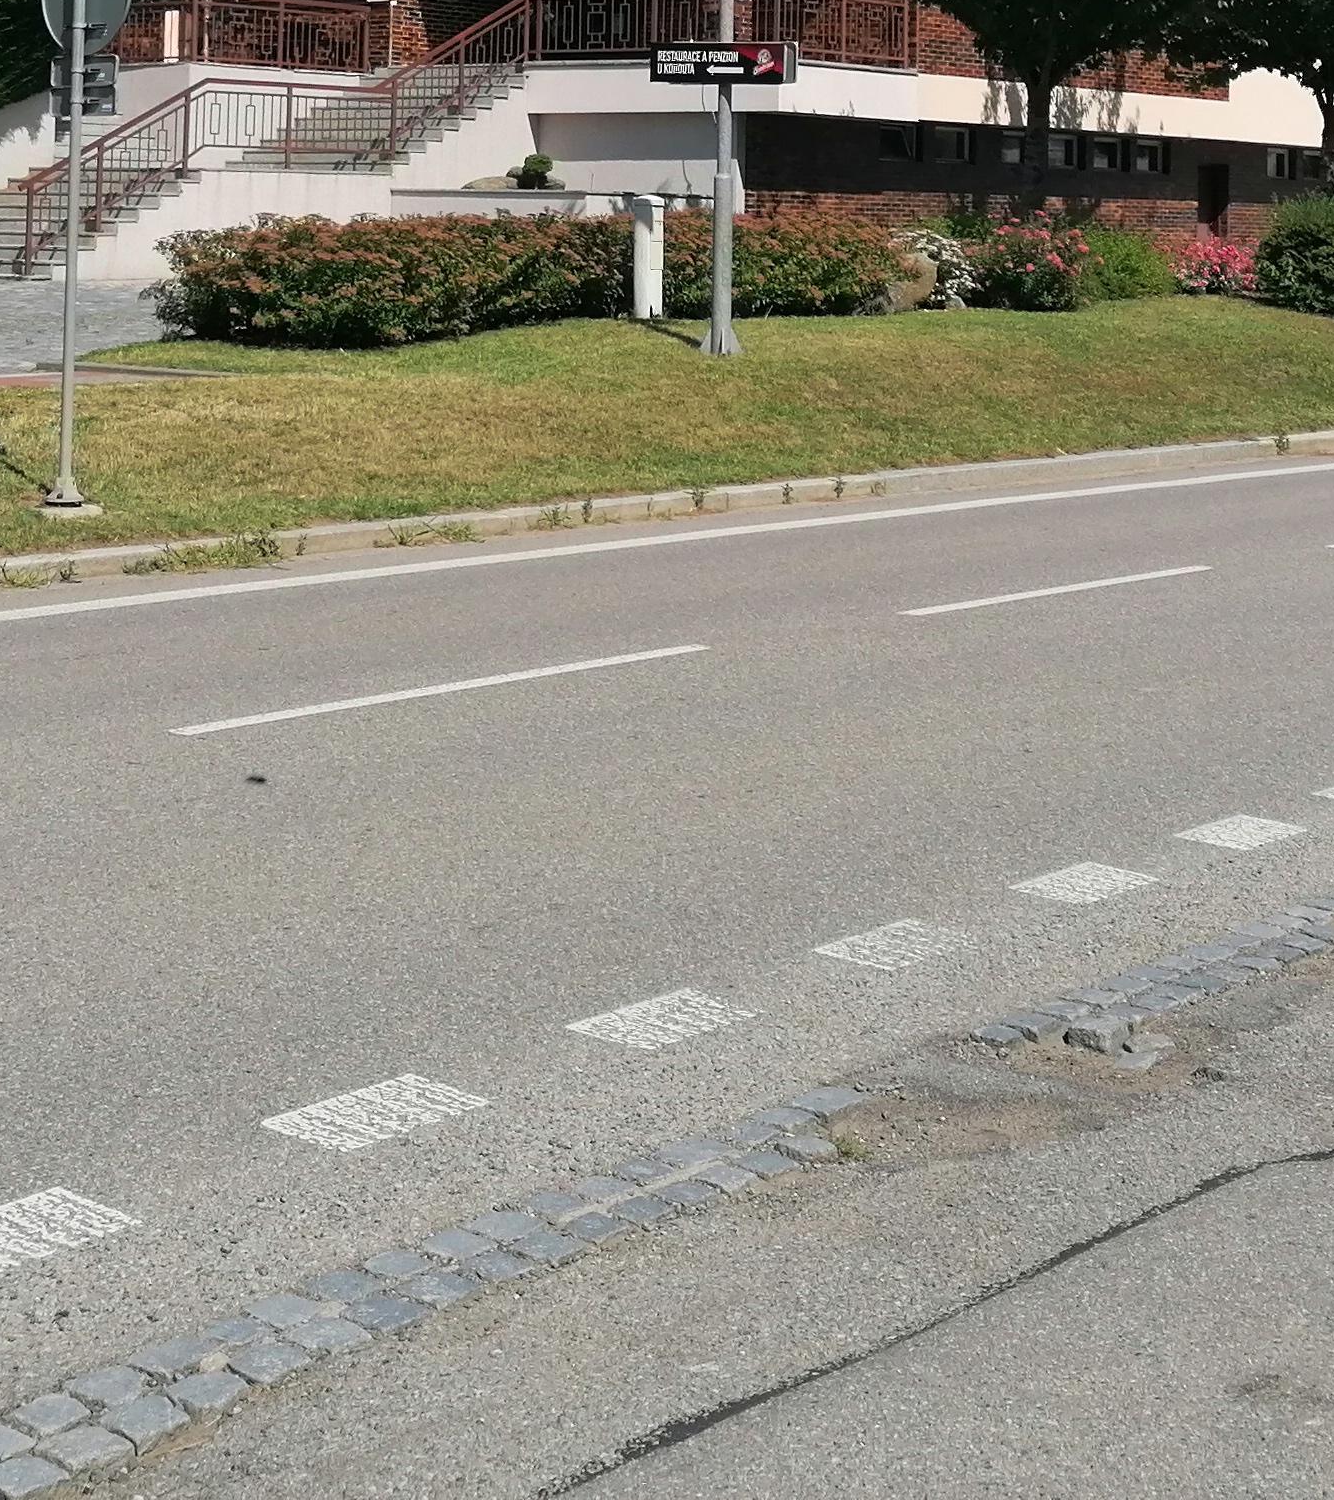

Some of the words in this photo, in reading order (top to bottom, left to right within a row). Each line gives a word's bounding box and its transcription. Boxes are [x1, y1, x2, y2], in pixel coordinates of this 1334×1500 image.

[657, 50, 701, 62] RESTAURACE
[701, 50, 708, 62] A
[708, 51, 739, 63] PENZION
[657, 63, 663, 75] U
